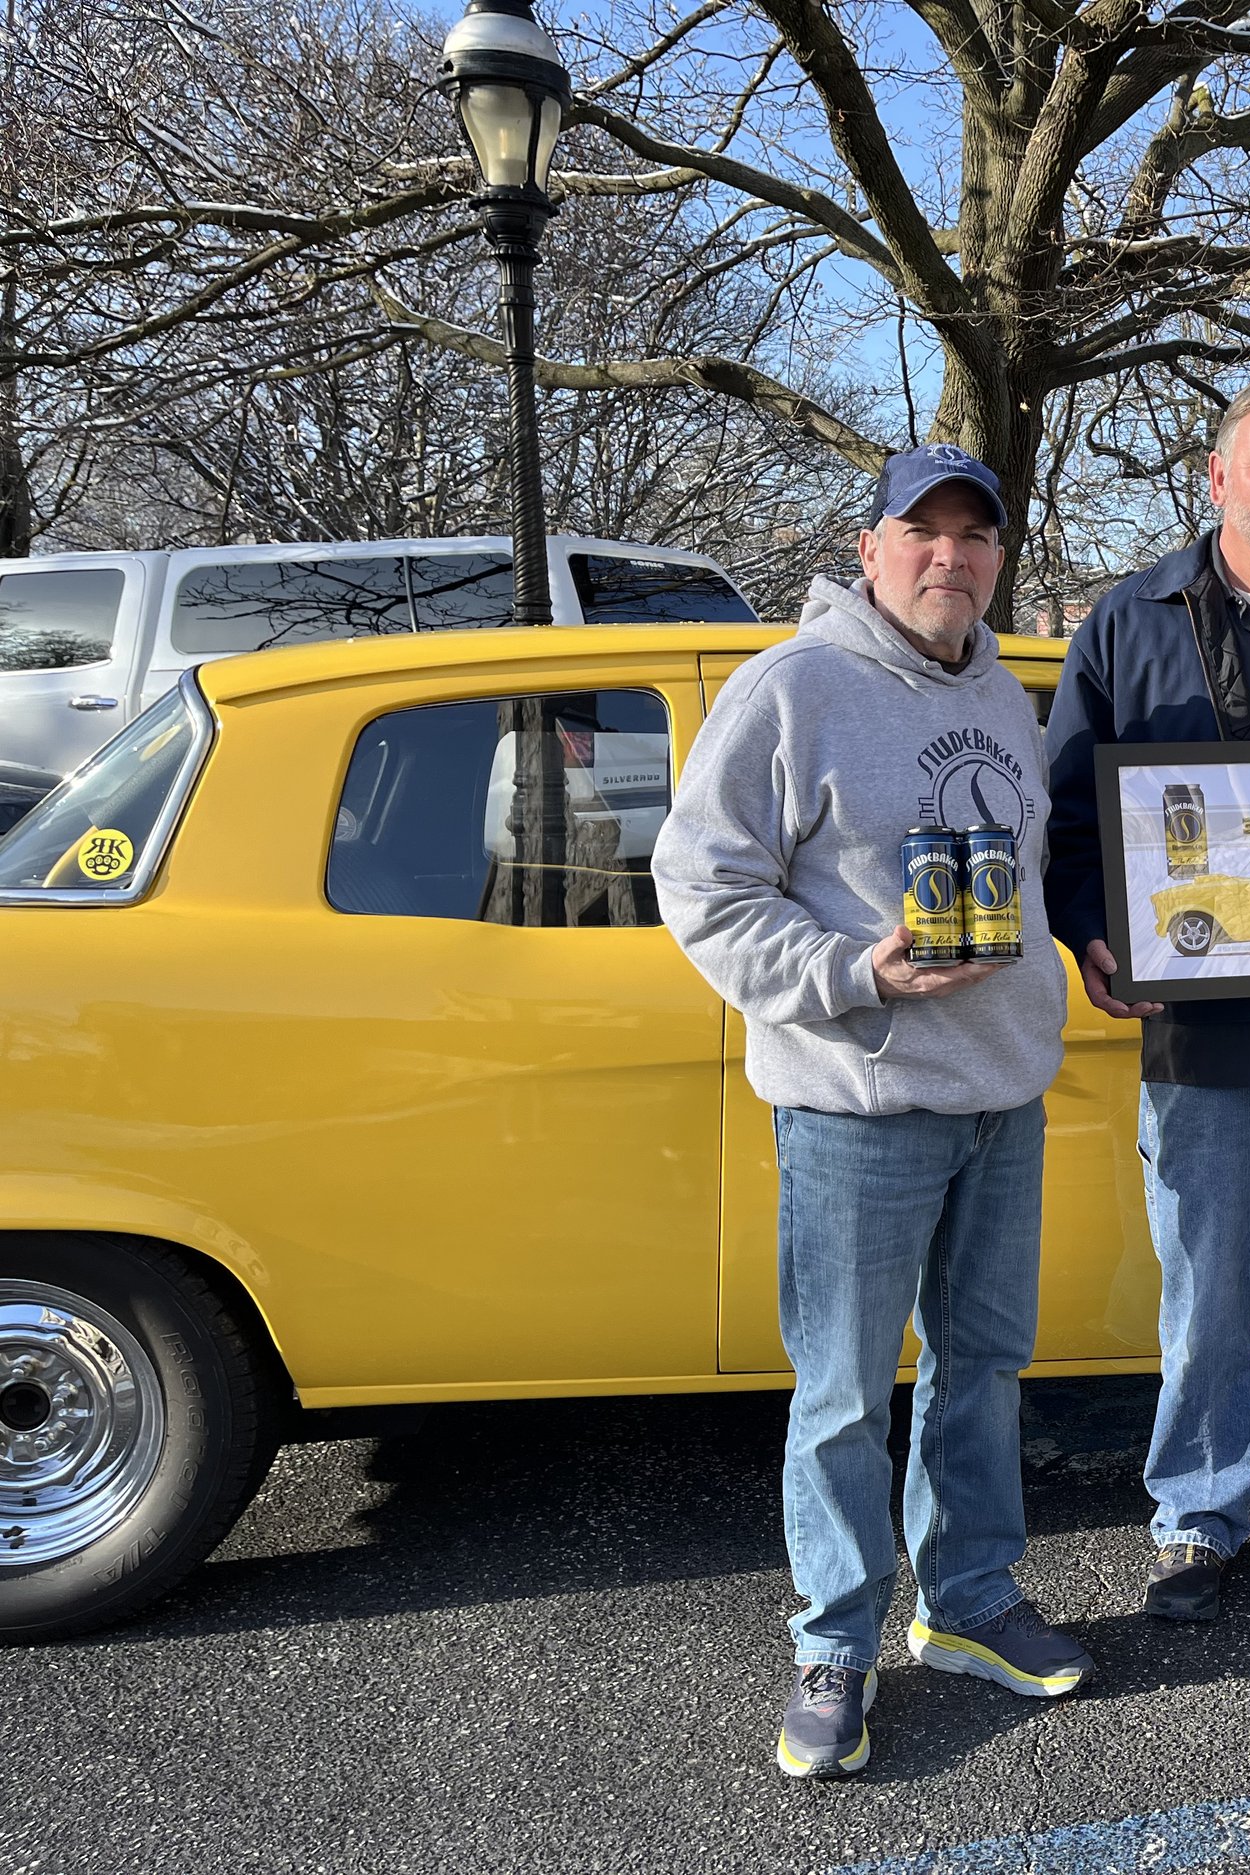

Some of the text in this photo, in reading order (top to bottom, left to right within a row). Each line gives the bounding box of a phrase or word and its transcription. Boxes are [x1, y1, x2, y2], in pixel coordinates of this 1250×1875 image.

[917, 727, 1023, 781] STUDEBAKER
[1165, 802, 1204, 817] STUDEBAKER
[907, 851, 959, 875] STUDEBAKER
[965, 849, 1016, 873] STUDEBAKER
[916, 916, 949, 926] BREWING
[973, 913, 1006, 922] BREWING
